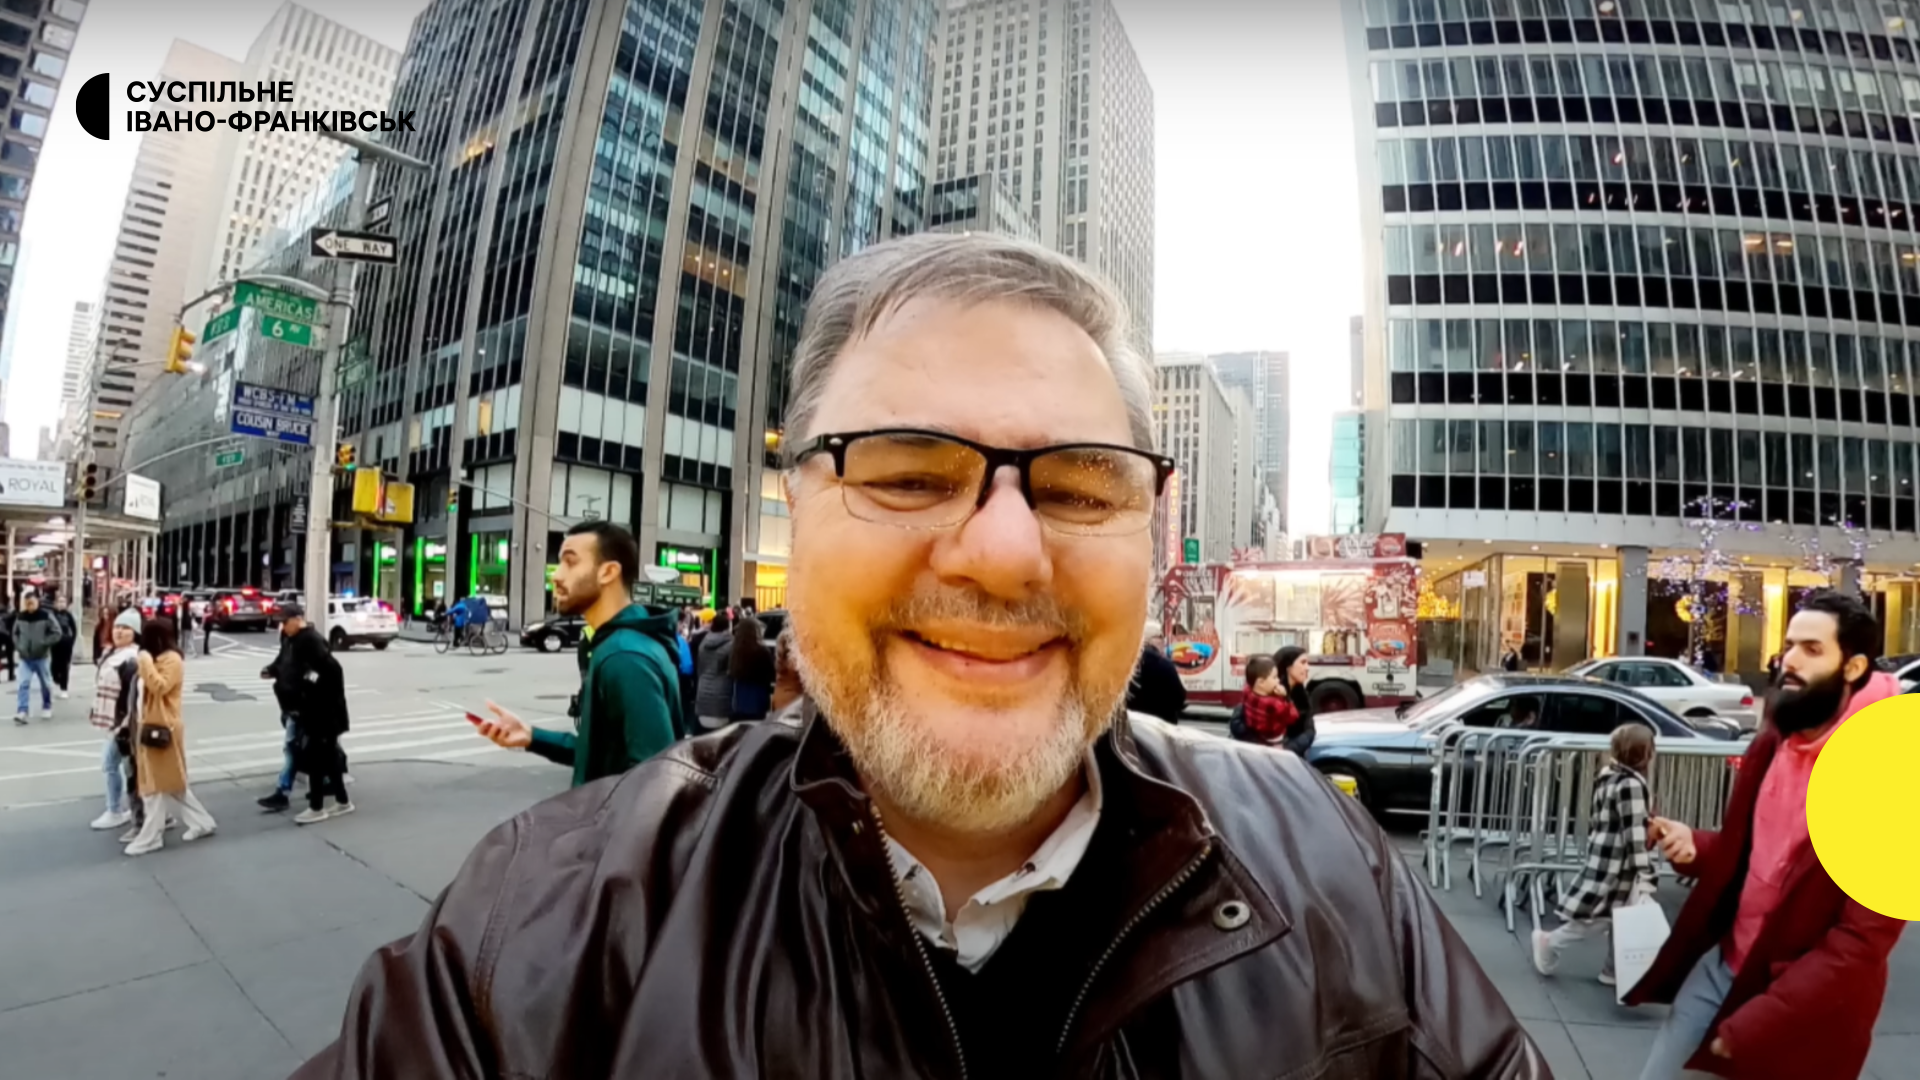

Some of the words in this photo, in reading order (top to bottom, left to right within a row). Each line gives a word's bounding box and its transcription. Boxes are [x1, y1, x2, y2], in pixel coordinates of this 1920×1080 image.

[324, 237, 350, 252] ONE
[362, 242, 388, 254] WAY
[244, 292, 314, 320] AMERICAS
[272, 320, 284, 337] 6
[237, 411, 273, 430] COUSIN
[8, 477, 57, 494] ROYAL
